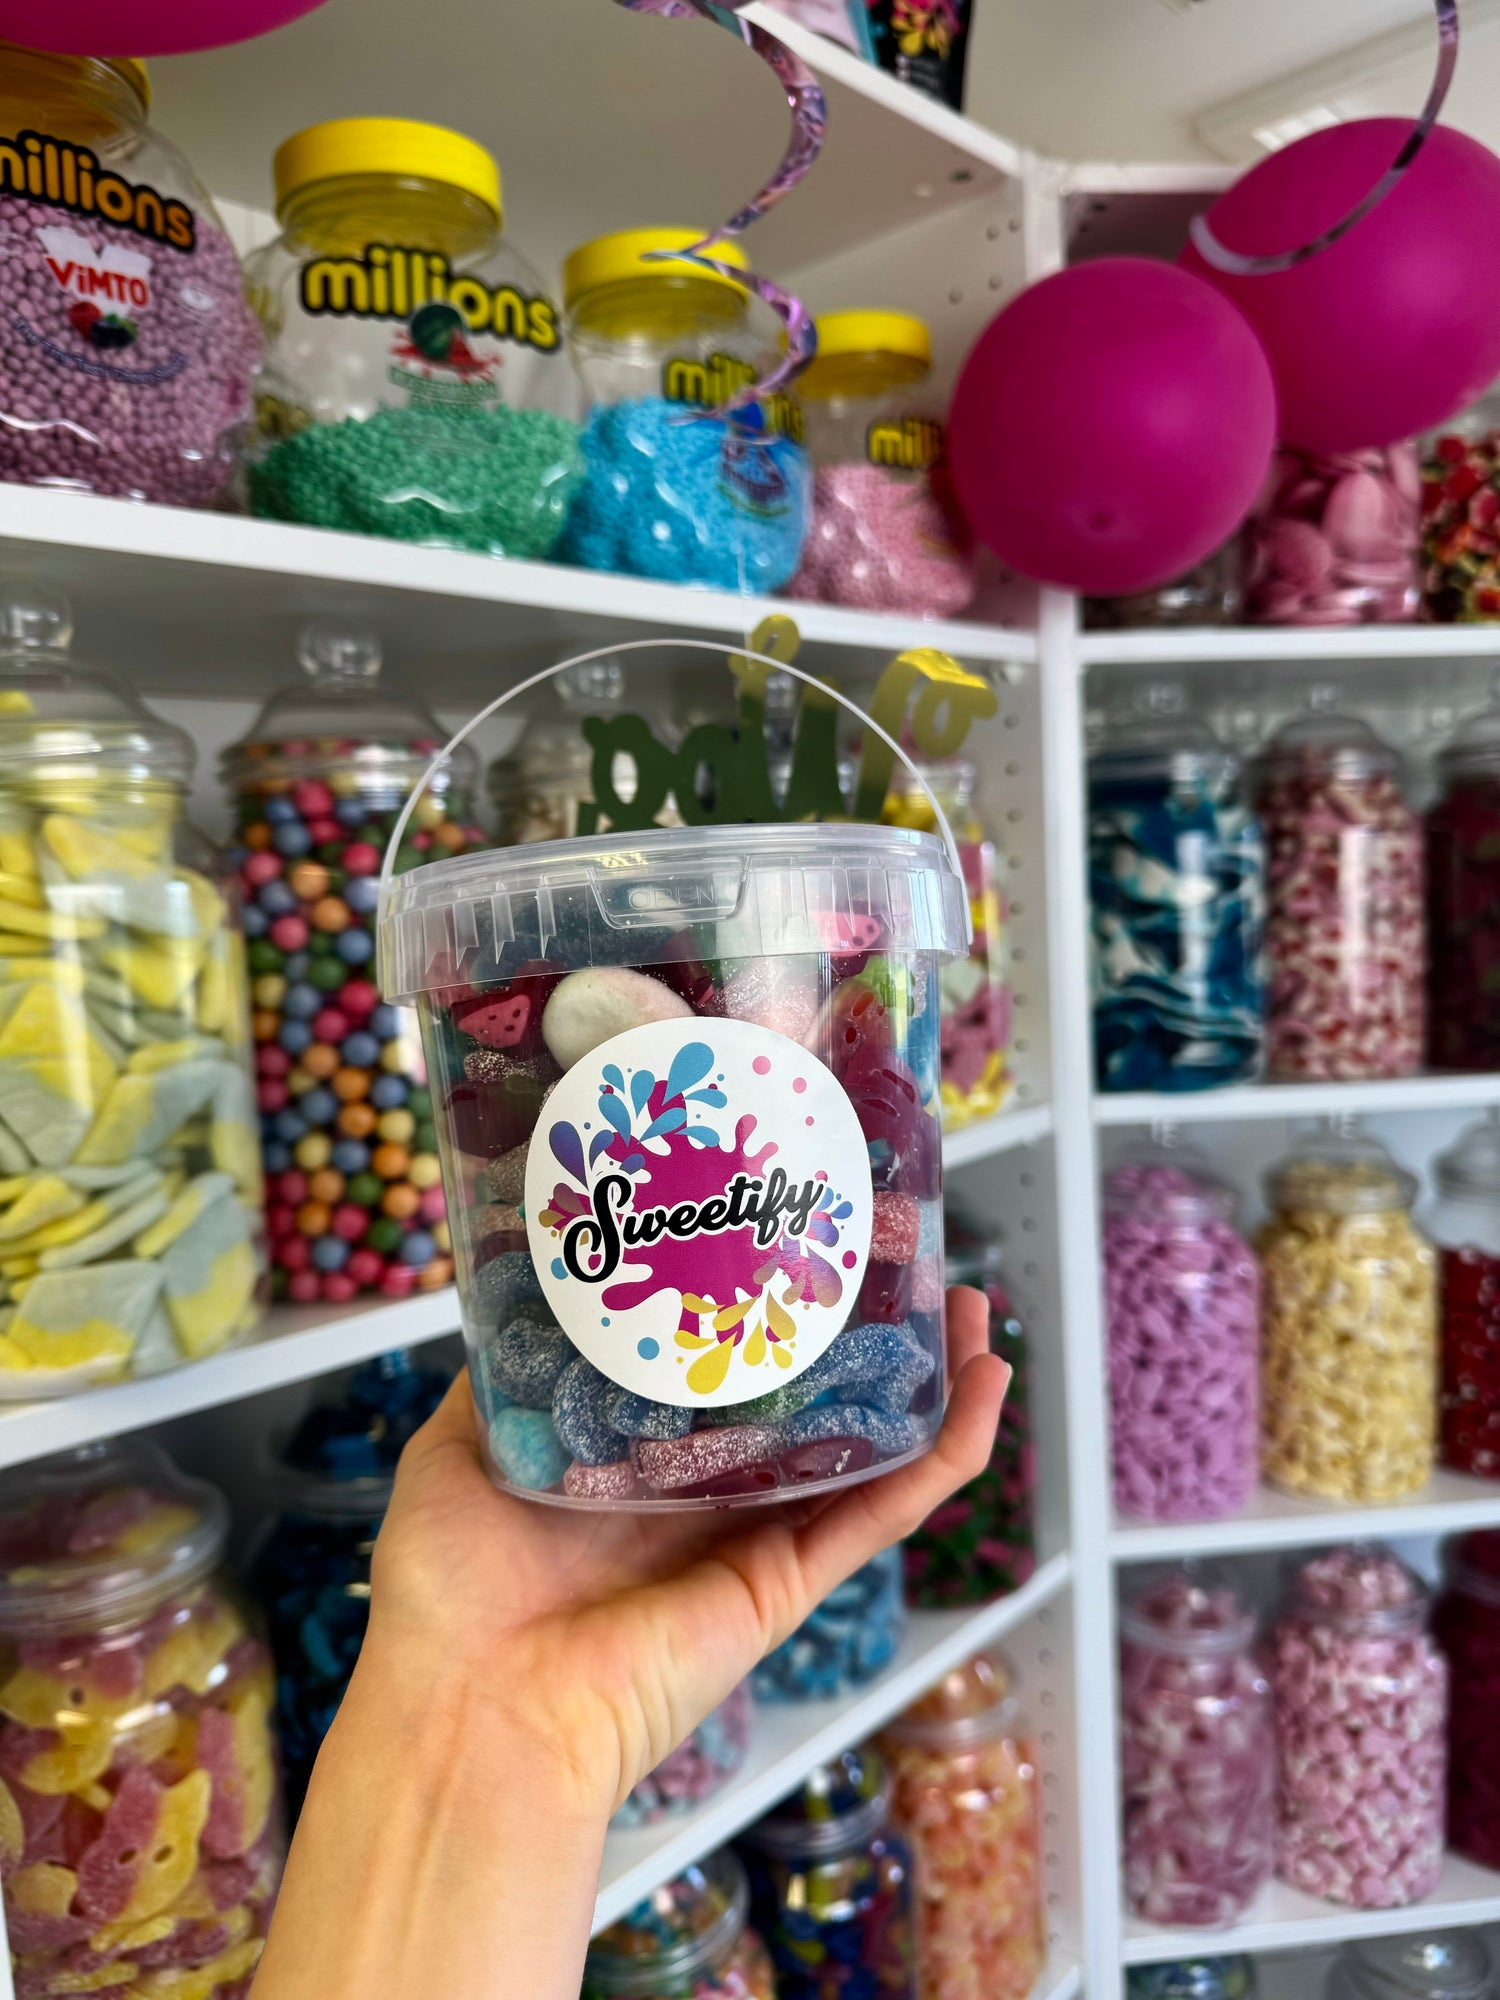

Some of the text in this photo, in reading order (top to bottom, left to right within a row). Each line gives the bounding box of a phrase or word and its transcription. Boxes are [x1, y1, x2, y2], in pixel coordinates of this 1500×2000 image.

[302, 245, 560, 353] millions
[628, 884, 717, 910] OPEN
[563, 1167, 824, 1283] Sweetify
